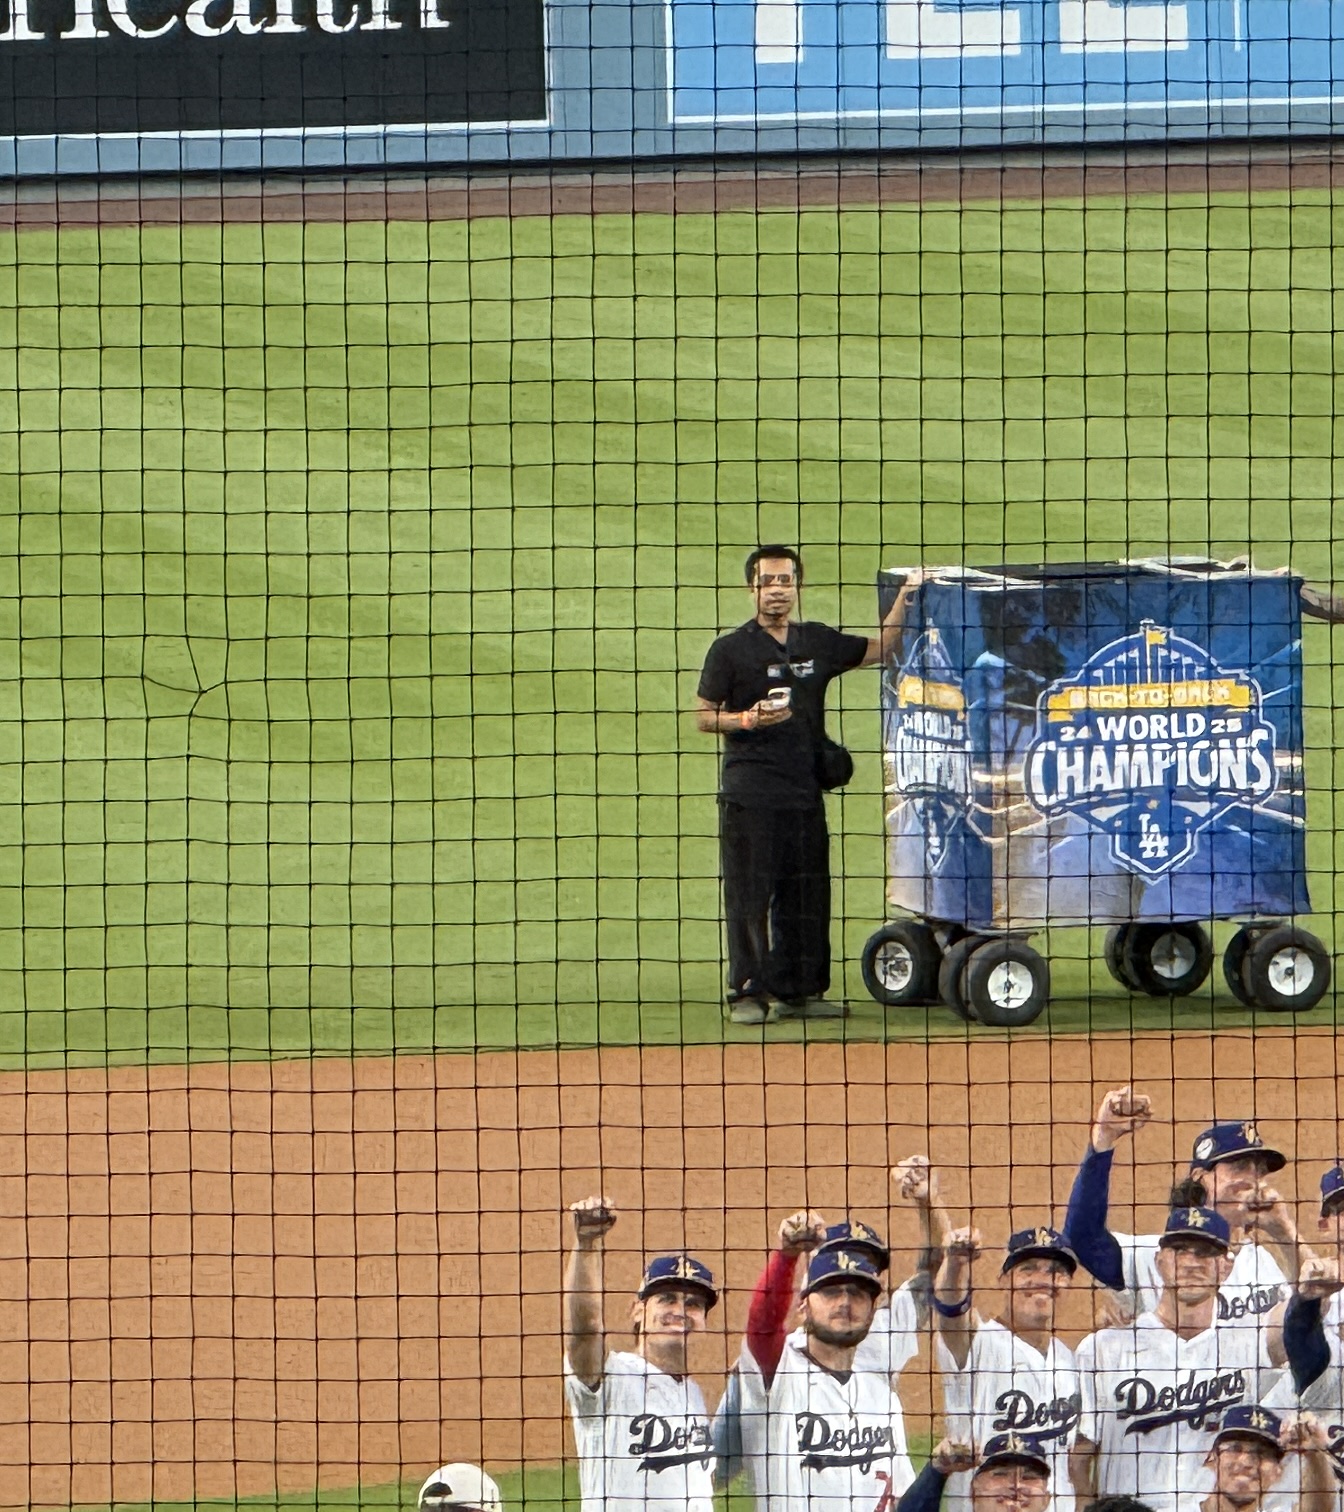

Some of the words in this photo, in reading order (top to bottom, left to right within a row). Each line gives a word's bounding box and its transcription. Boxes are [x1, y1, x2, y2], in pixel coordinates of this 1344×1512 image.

[1097, 712, 1206, 741] WORLD
[1030, 729, 1271, 808] CHAMPIONS
[1115, 1368, 1247, 1436] Dodgers
